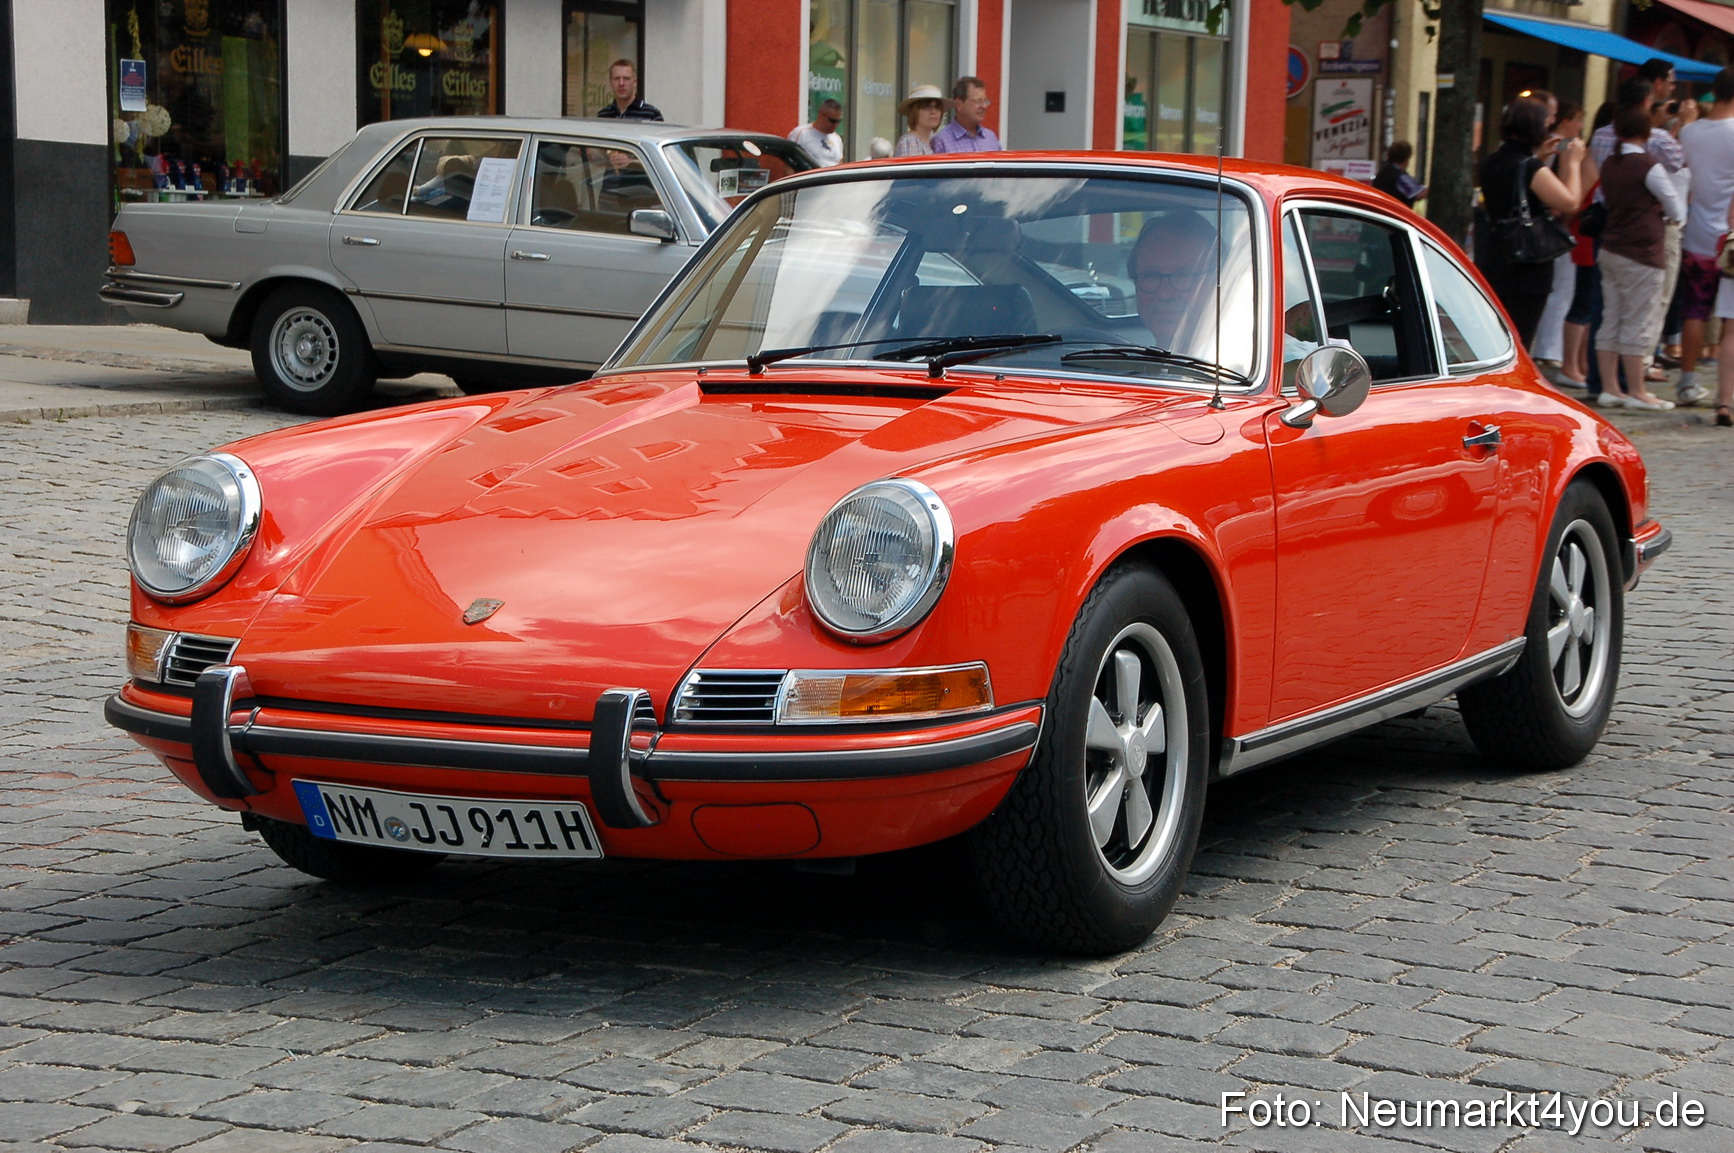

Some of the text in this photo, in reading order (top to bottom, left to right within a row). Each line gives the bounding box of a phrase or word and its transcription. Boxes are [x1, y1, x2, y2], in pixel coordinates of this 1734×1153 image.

[370, 60, 417, 91] Eilles
[442, 69, 486, 98] Eilles
[1316, 118, 1368, 141] VENEZIA
[314, 814, 325, 827] D
[323, 792, 384, 839] NM
